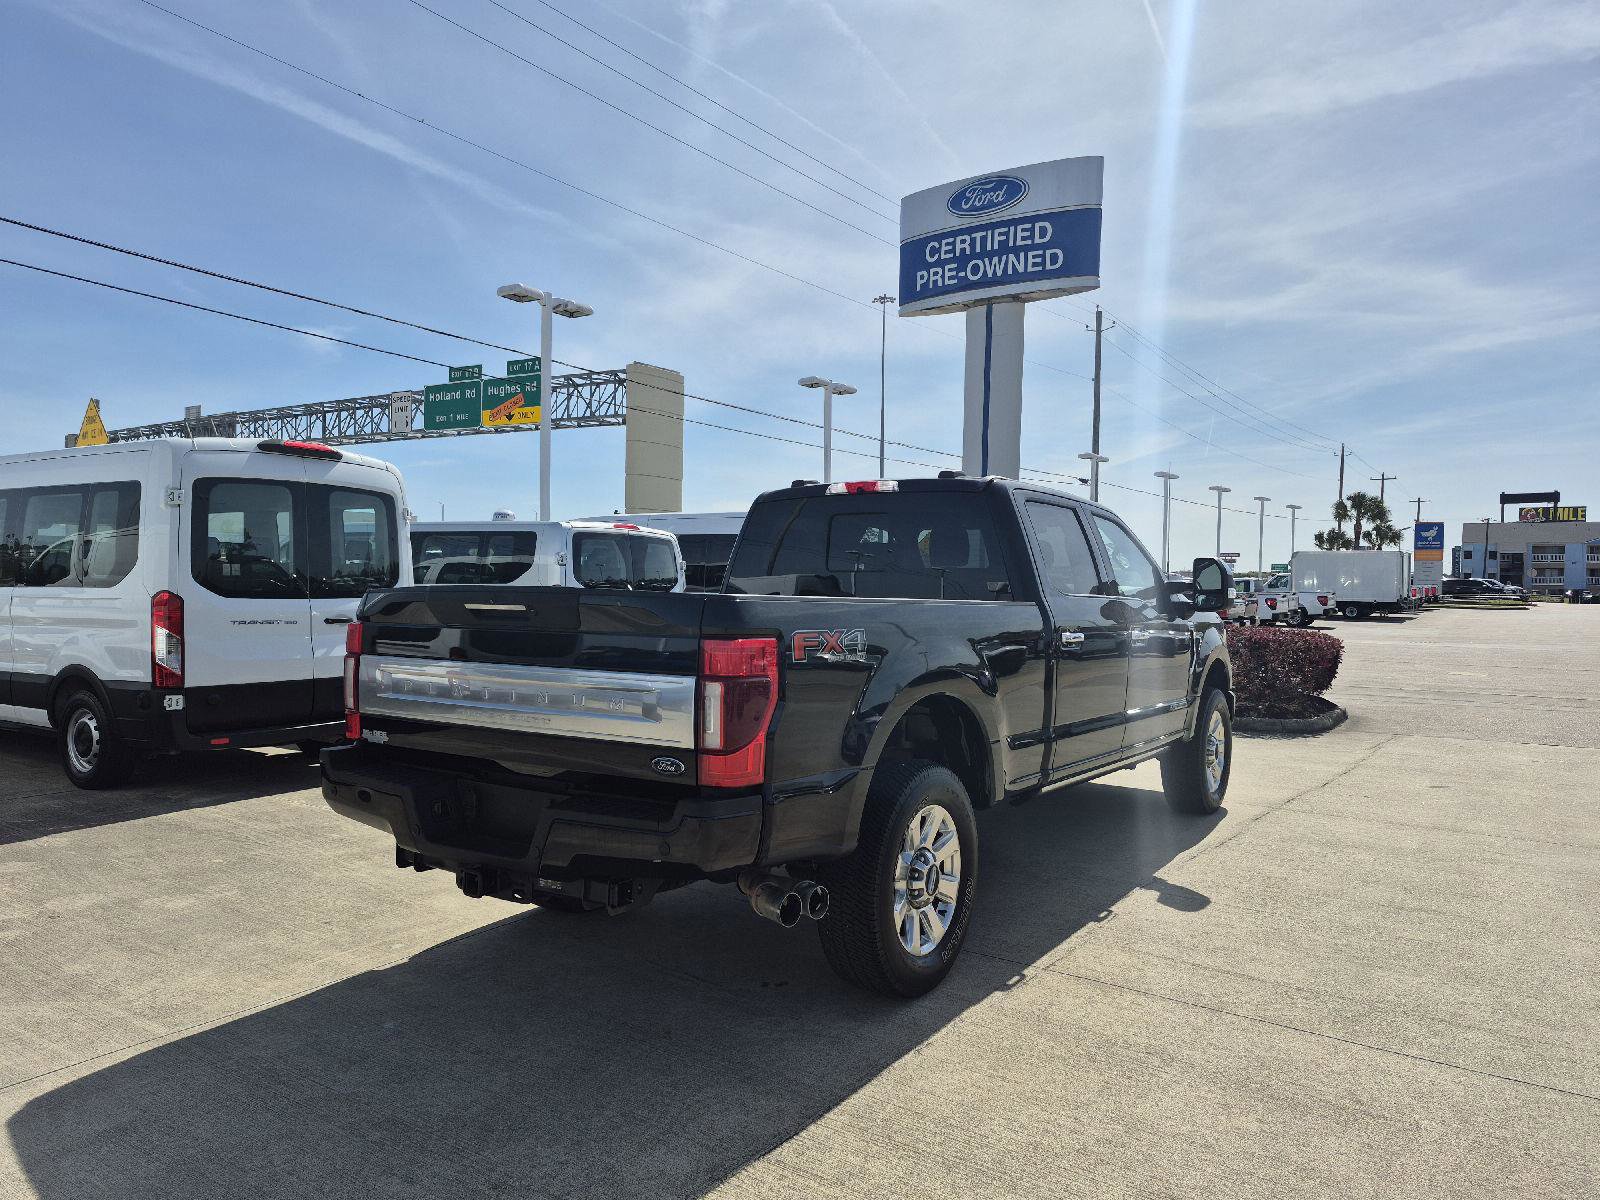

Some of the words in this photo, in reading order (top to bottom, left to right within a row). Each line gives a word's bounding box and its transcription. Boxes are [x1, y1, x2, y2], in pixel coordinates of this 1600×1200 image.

[961, 183, 1007, 210] Ford
[925, 221, 1053, 263] CERTIFIED
[916, 249, 1064, 292] PRE-OWNED
[509, 364, 521, 372] EXIT
[524, 362, 533, 371] 17
[429, 390, 461, 402] Holland
[465, 388, 476, 399] Rd
[488, 384, 521, 397] Hughes
[525, 381, 537, 392] Rd
[392, 395, 411, 404] SPEED
[395, 405, 409, 413] LIMIT
[456, 413, 469, 421] MILE
[791, 629, 867, 663] FX4
[403, 679, 625, 712] PLATINUM
[657, 760, 676, 772] Ford
